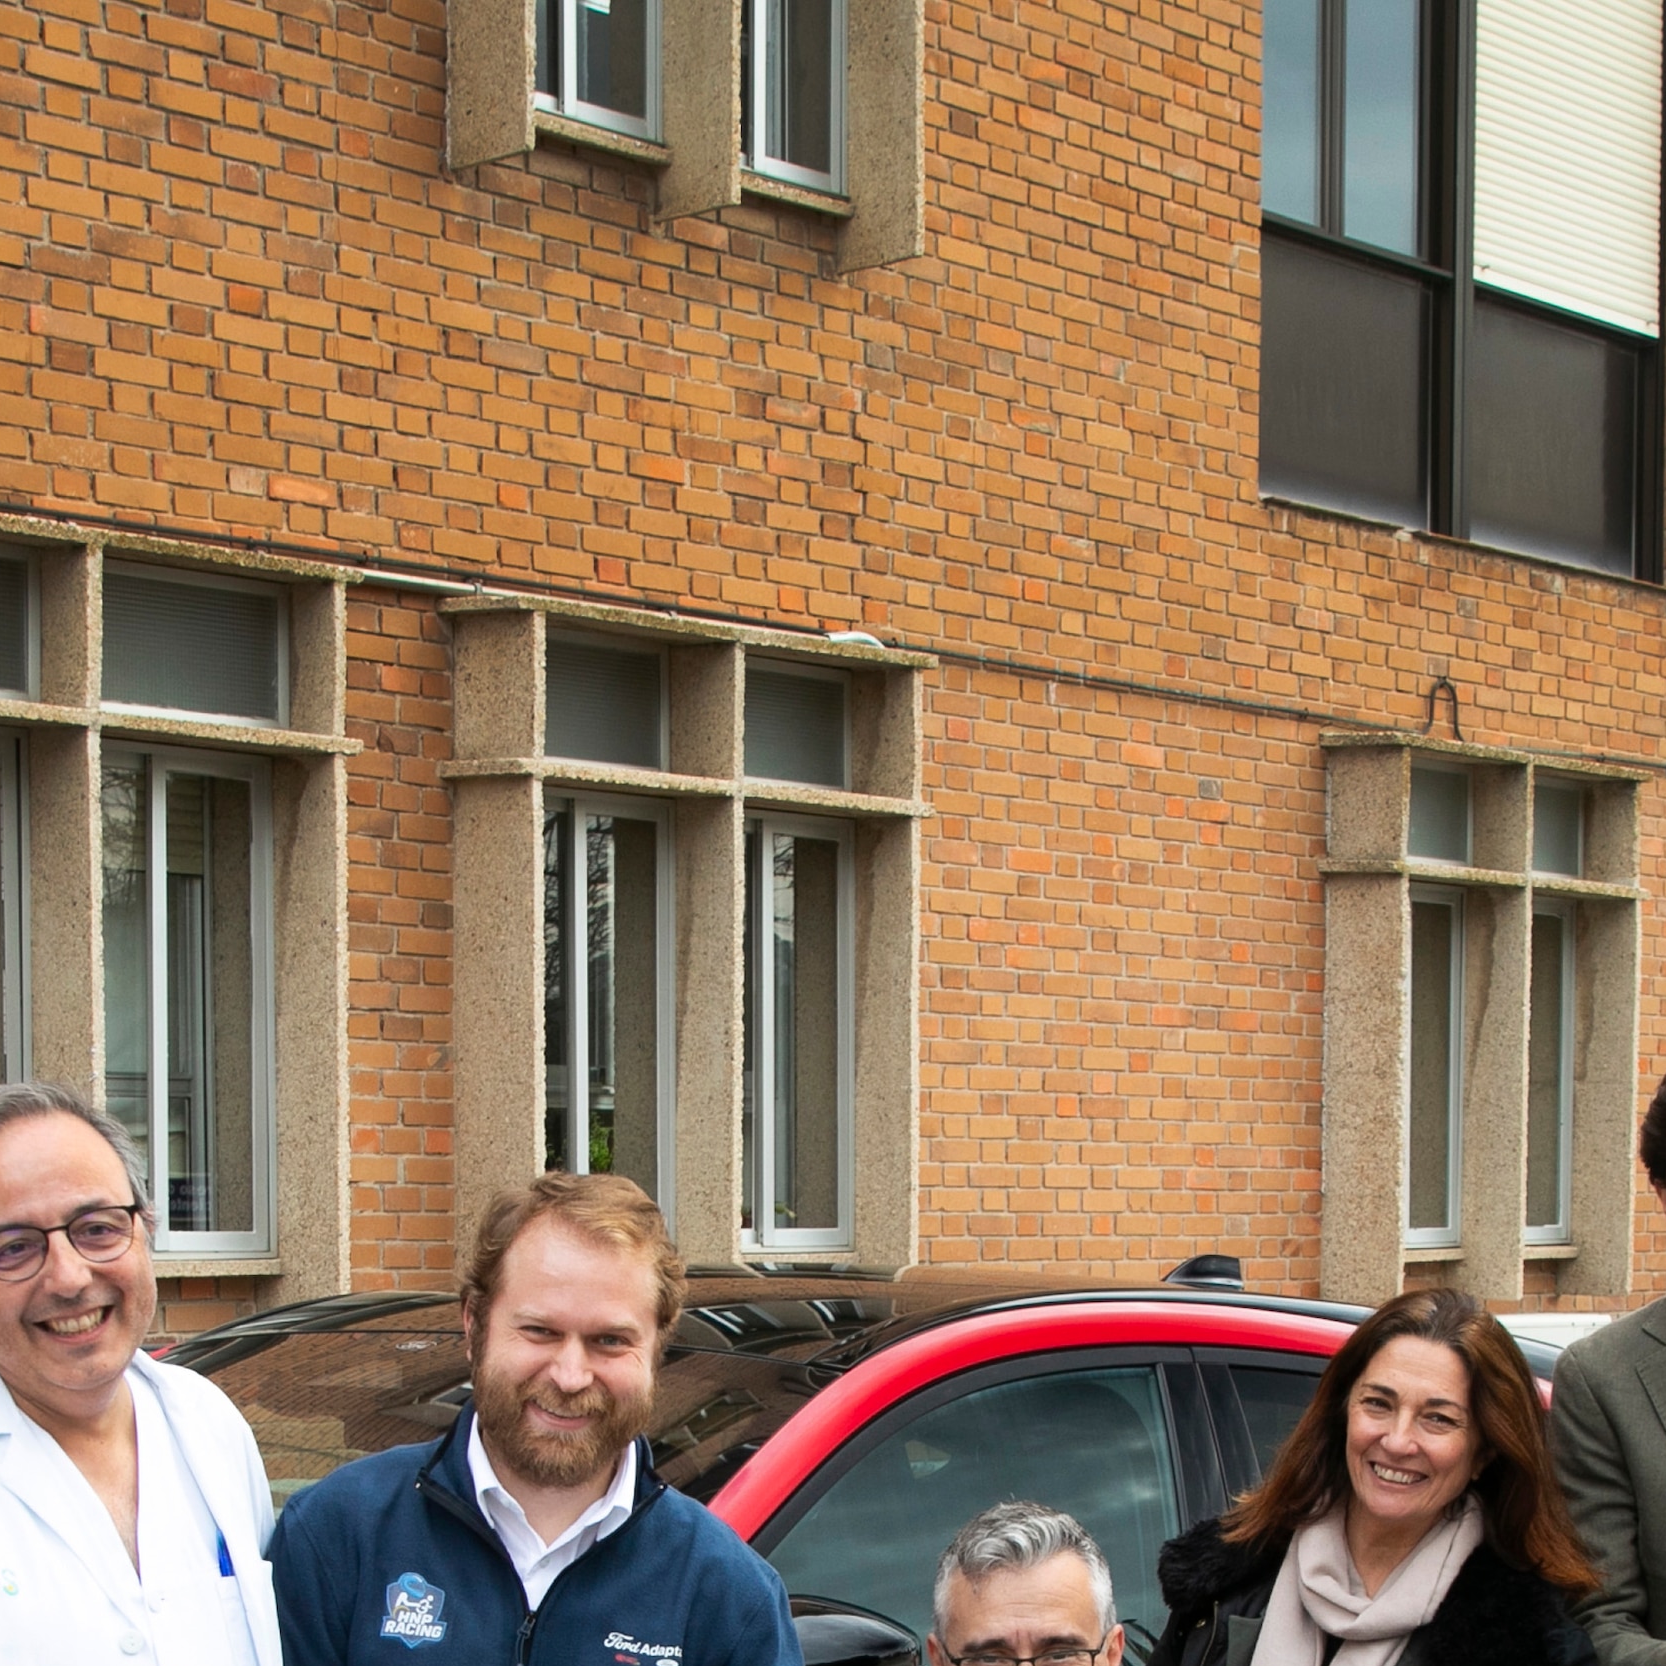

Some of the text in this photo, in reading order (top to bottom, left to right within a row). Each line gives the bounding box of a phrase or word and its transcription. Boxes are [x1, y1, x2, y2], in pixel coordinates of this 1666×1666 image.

[397, 1610, 434, 1625] HNP
[384, 1620, 443, 1638] RACING
[604, 1632, 641, 1653] Ford
